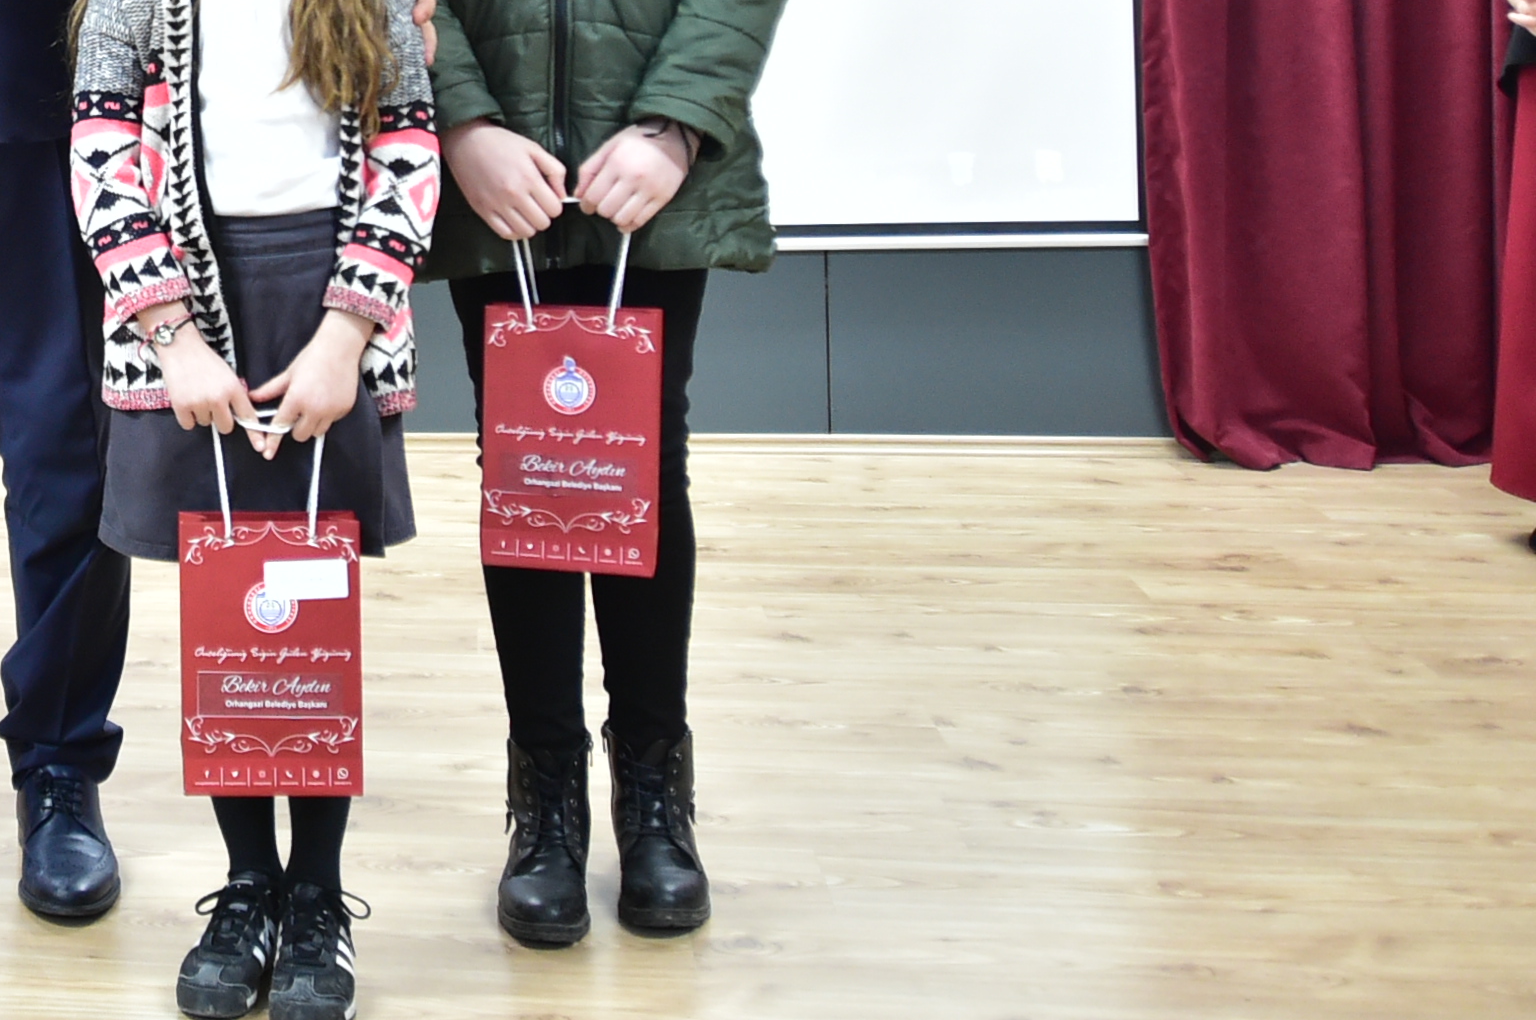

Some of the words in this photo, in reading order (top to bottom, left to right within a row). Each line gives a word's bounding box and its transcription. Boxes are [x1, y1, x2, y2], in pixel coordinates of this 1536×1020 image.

[519, 454, 567, 474] Bekir
[569, 458, 626, 480] Aydın
[220, 674, 269, 694] Bekir
[272, 675, 332, 698] Aydın
[225, 699, 264, 709] Orhangazi
[264, 699, 297, 710] Belediye
[297, 699, 328, 710] Başkanı
